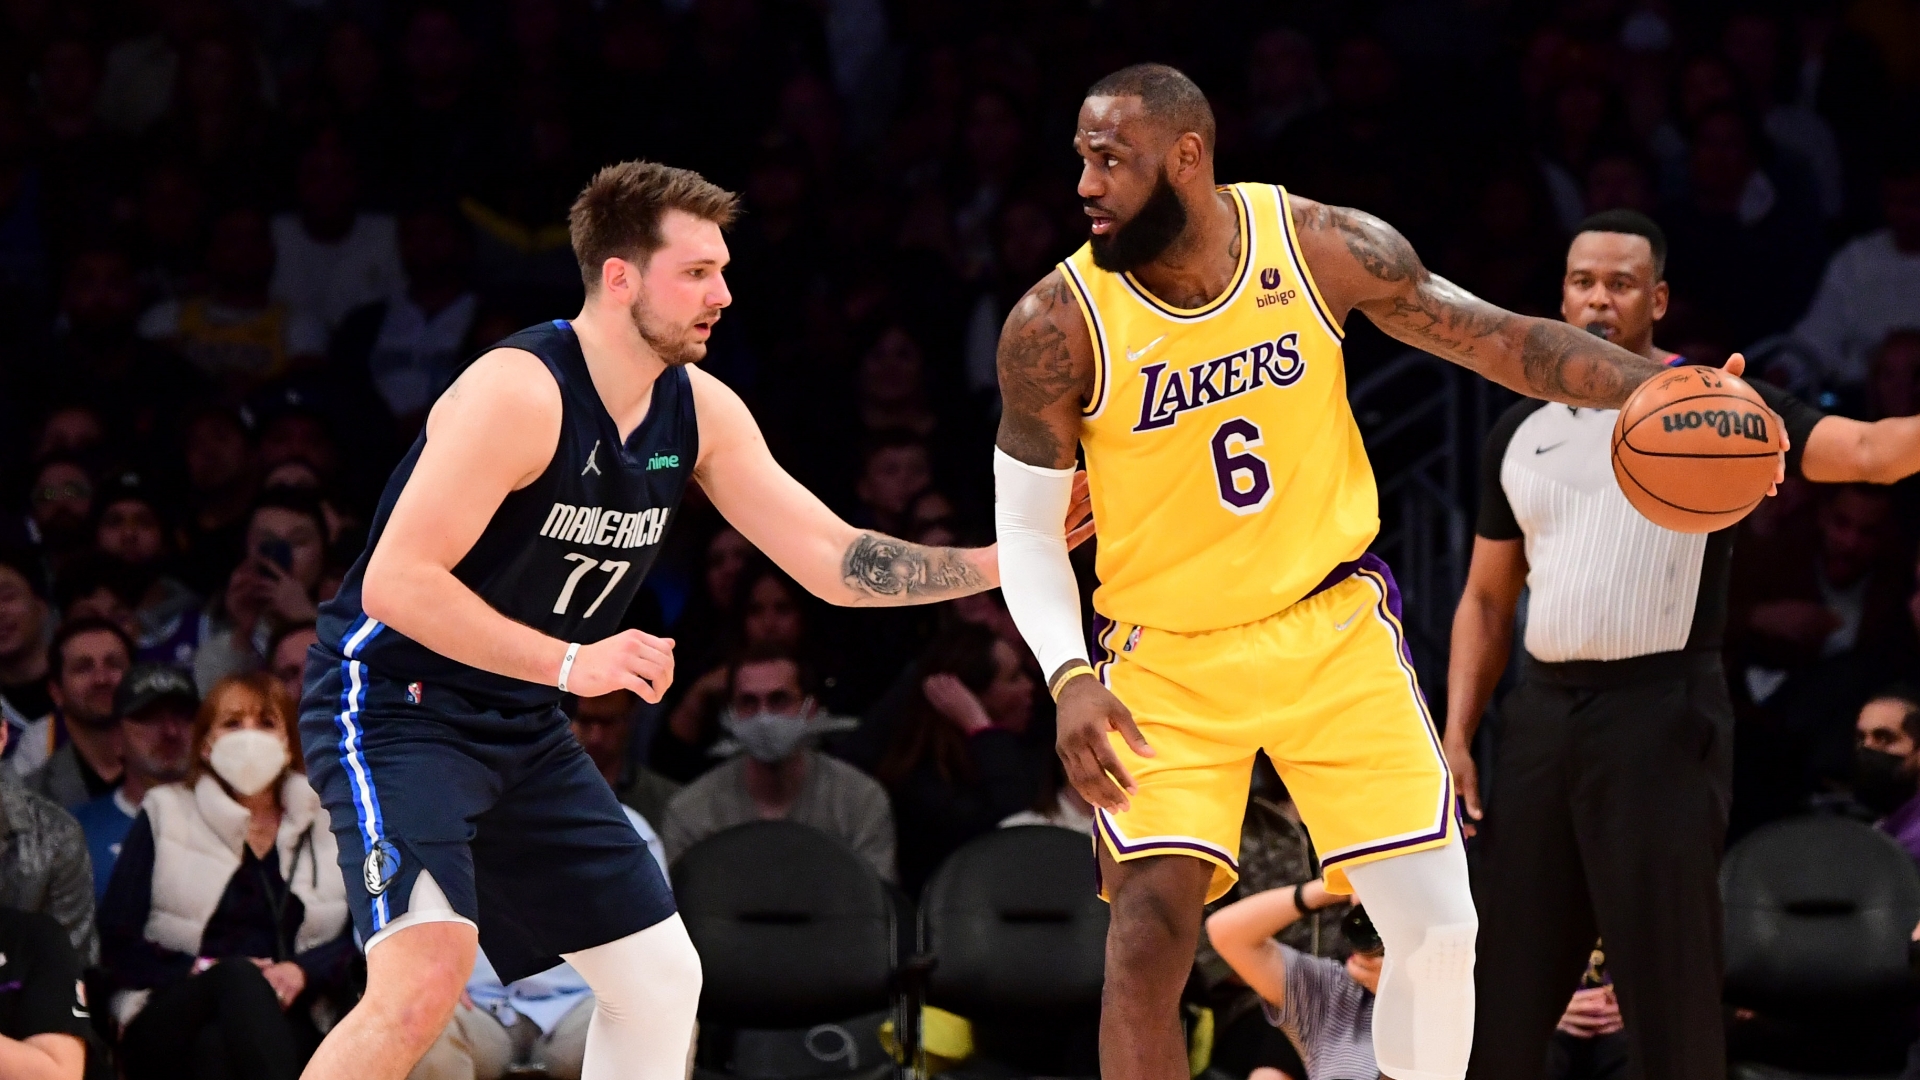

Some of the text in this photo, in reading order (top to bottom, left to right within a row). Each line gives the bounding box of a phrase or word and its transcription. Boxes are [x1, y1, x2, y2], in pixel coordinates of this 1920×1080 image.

[1256, 289, 1296, 308] bibigo
[1131, 332, 1306, 434] LAKERS
[1662, 410, 1769, 443] Wilson
[1210, 416, 1274, 515] 6
[539, 502, 671, 549] MAVERICK
[552, 552, 631, 619] 77
